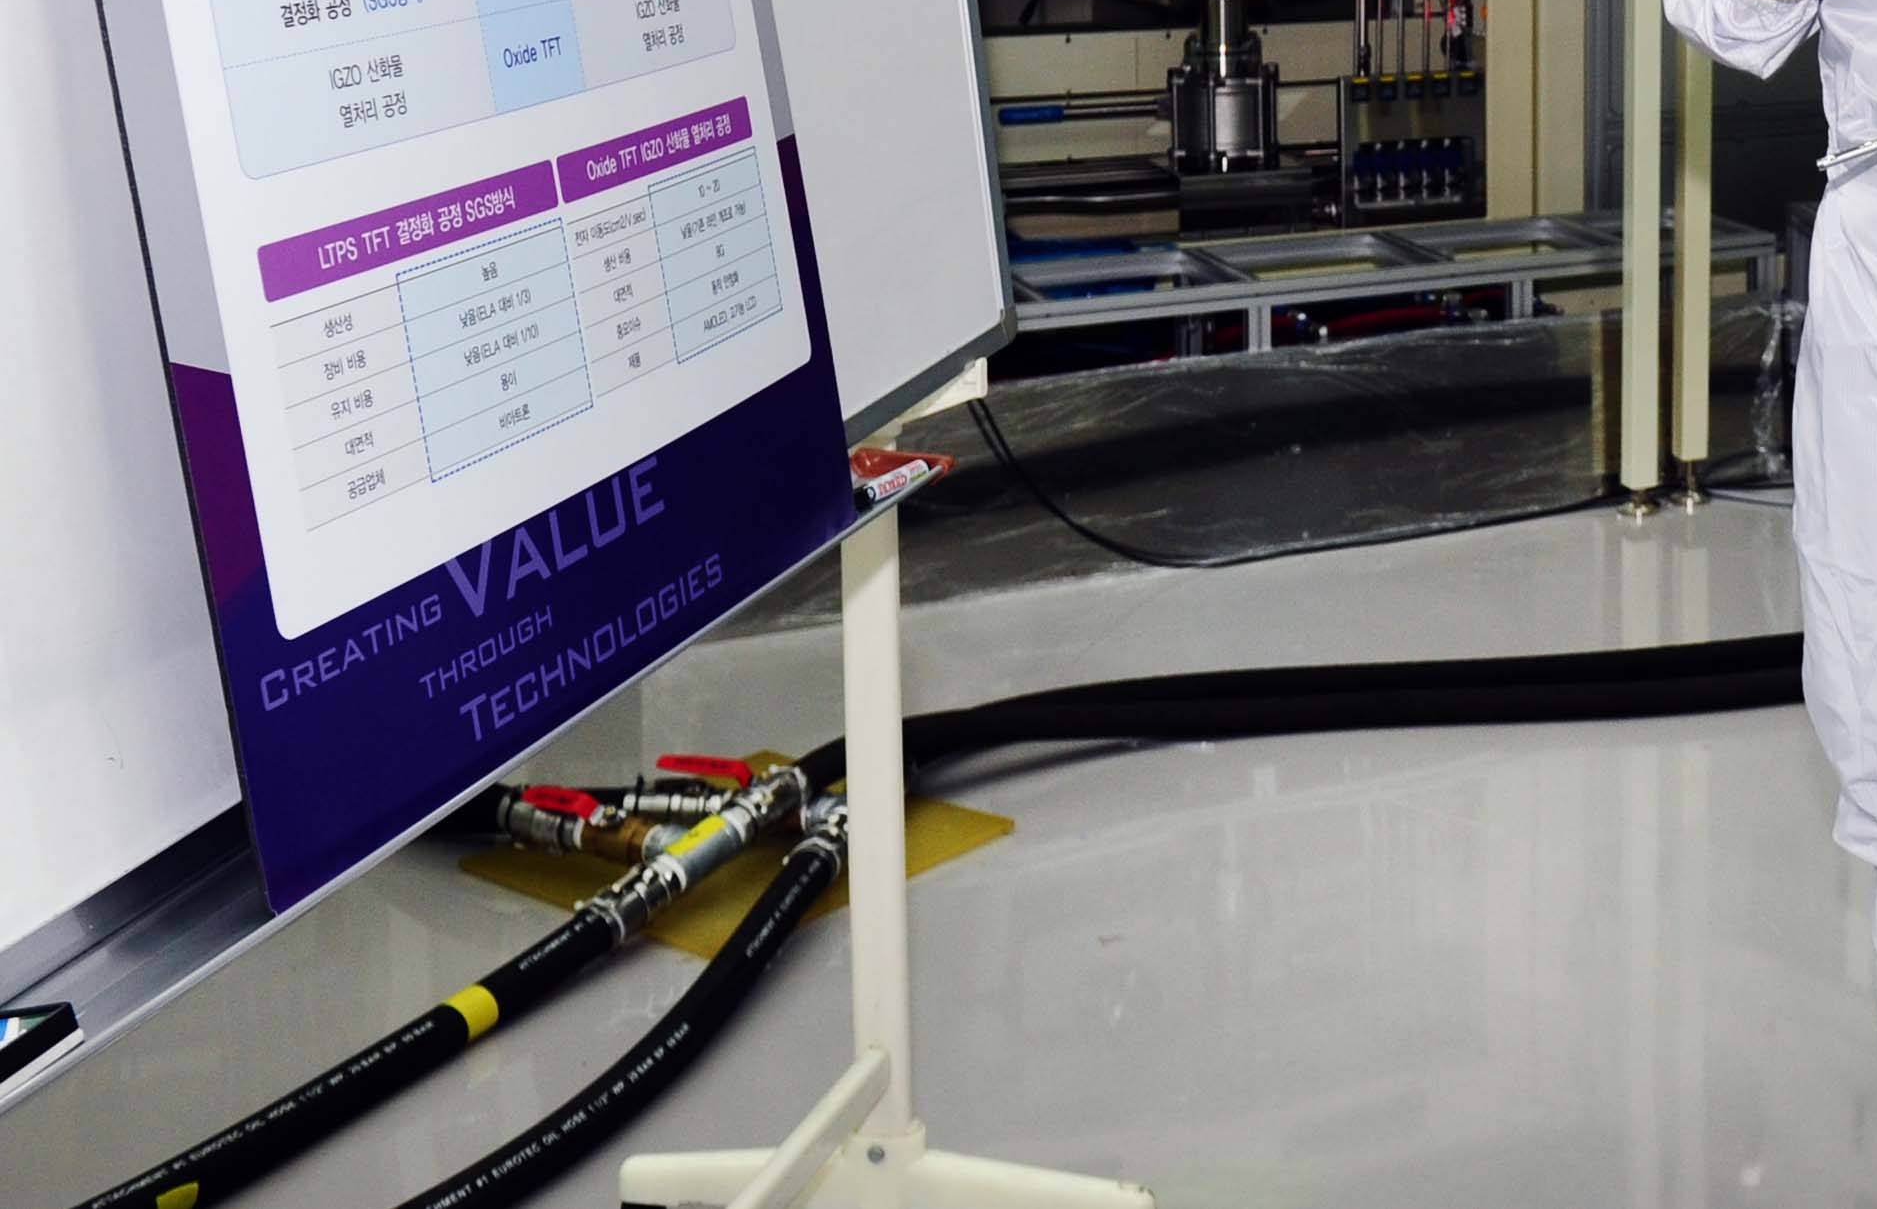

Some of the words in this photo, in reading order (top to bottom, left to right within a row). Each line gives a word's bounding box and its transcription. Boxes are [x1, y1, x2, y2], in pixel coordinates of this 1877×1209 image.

[503, 45, 538, 69] Oxide
[540, 36, 561, 59] TFT
[668, 24, 685, 46] 공정
[328, 64, 362, 91] IGZO
[366, 54, 404, 83] 산화물
[339, 96, 378, 129] 열처리
[382, 91, 408, 119] 공정
[586, 155, 617, 182] Oxide
[618, 146, 638, 170] TFT
[640, 138, 664, 164] IGZO
[715, 113, 732, 136] 공정
[317, 237, 358, 270] LTPS
[361, 226, 391, 255] TFT
[396, 214, 435, 245] 결정화
[437, 202, 463, 233] 공정
[465, 185, 516, 223] SGS방식
[323, 314, 353, 339] 생산성
[323, 355, 343, 381] 장비
[347, 350, 366, 370] 비용
[330, 400, 351, 420] 유지
[354, 389, 373, 409] 비용
[345, 431, 375, 456] 대면적
[258, 593, 443, 714] CREATING
[444, 454, 667, 619] VALUE
[418, 605, 553, 701] THROUGH
[458, 552, 724, 743] TECHNOLOGIES
